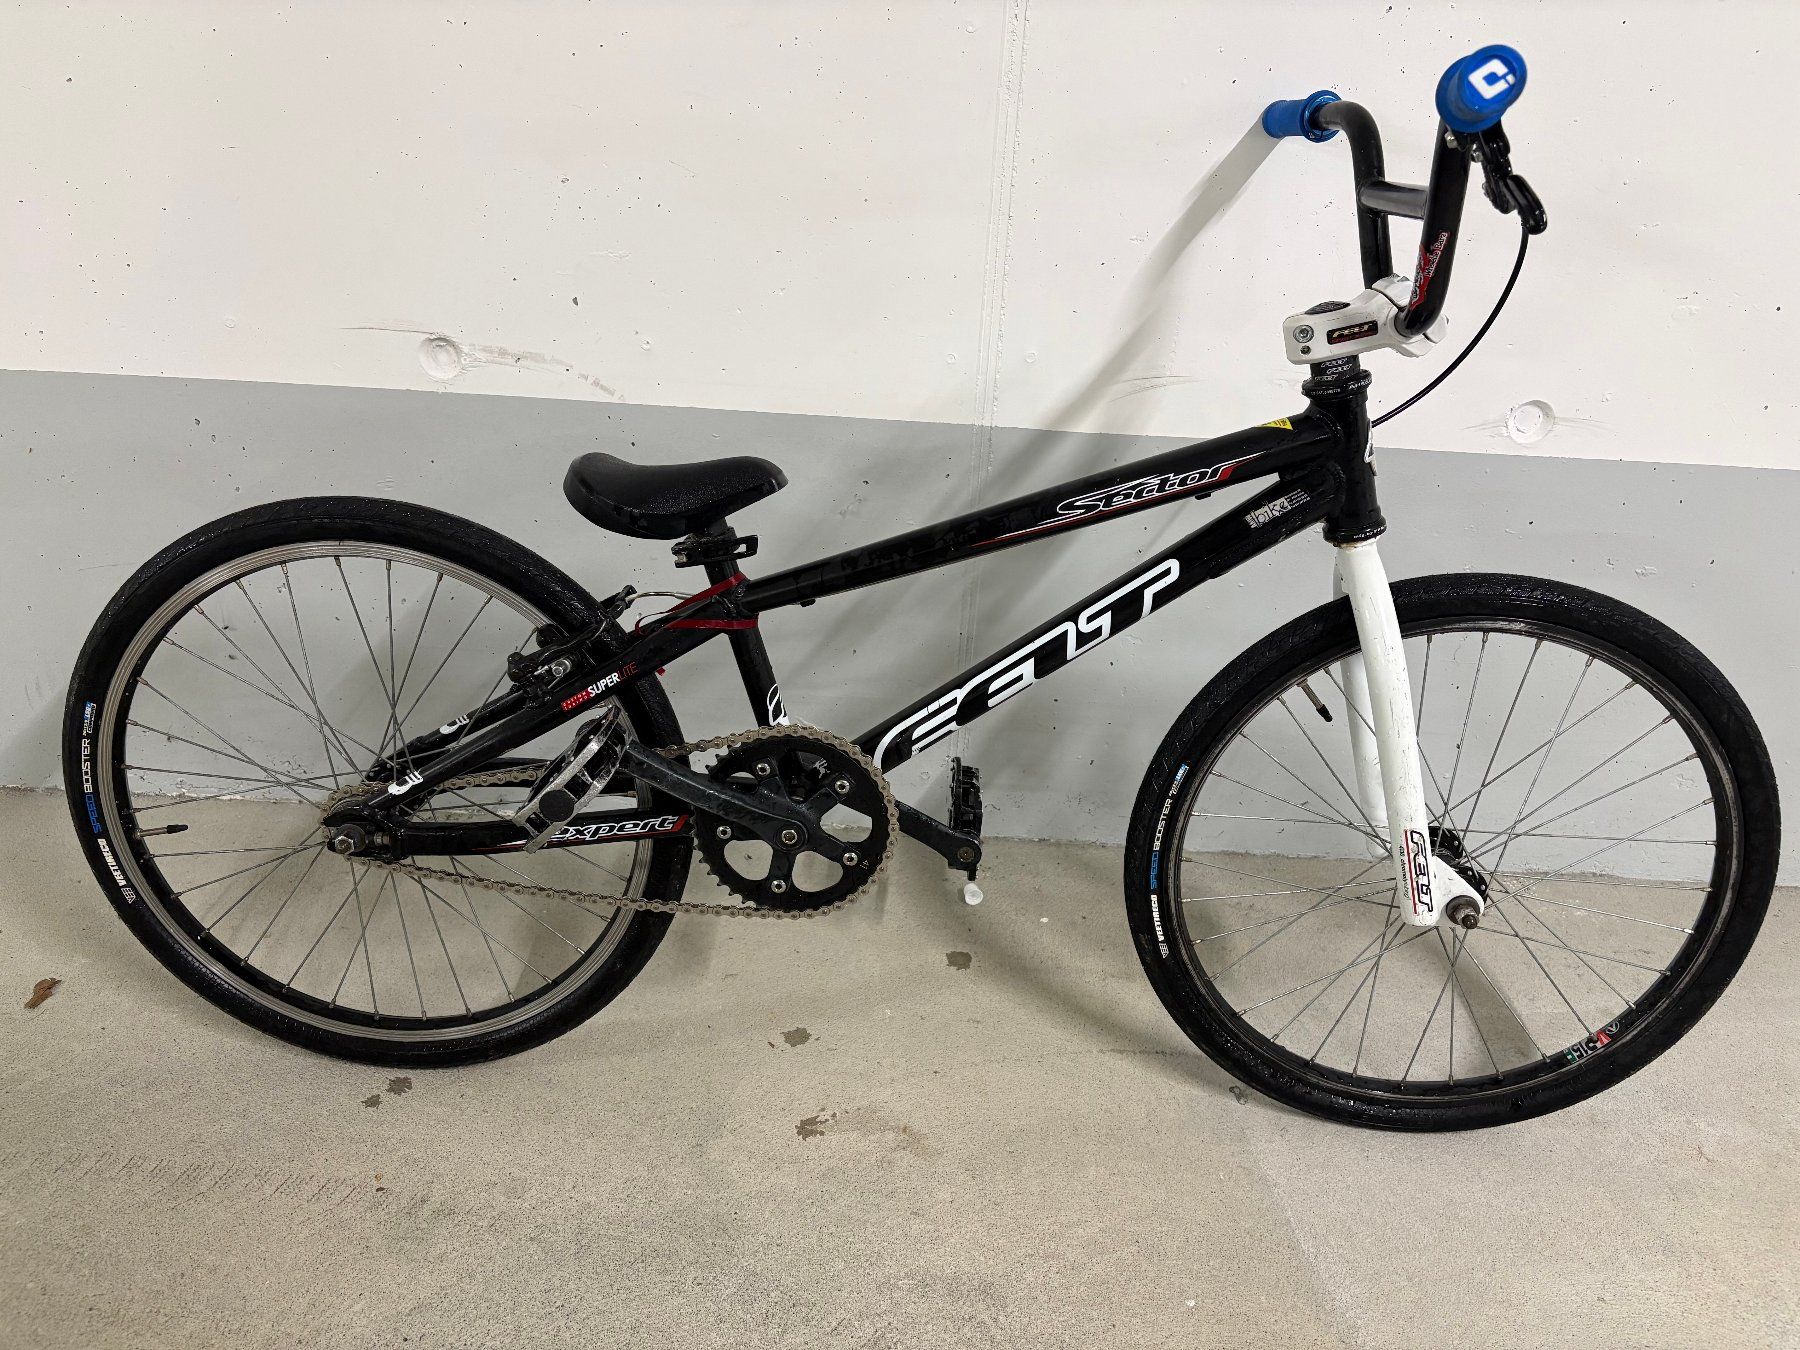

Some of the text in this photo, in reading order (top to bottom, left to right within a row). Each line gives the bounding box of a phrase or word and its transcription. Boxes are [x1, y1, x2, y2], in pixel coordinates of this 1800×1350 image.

[1056, 462, 1234, 516] Sector
[872, 558, 1180, 768] FELT
[81, 738, 93, 793] BOOSTER
[85, 794, 102, 834] SPEED
[1153, 798, 1173, 850] BOOSTER
[1150, 851, 1159, 889] SPEED
[1410, 830, 1433, 912] FELT
